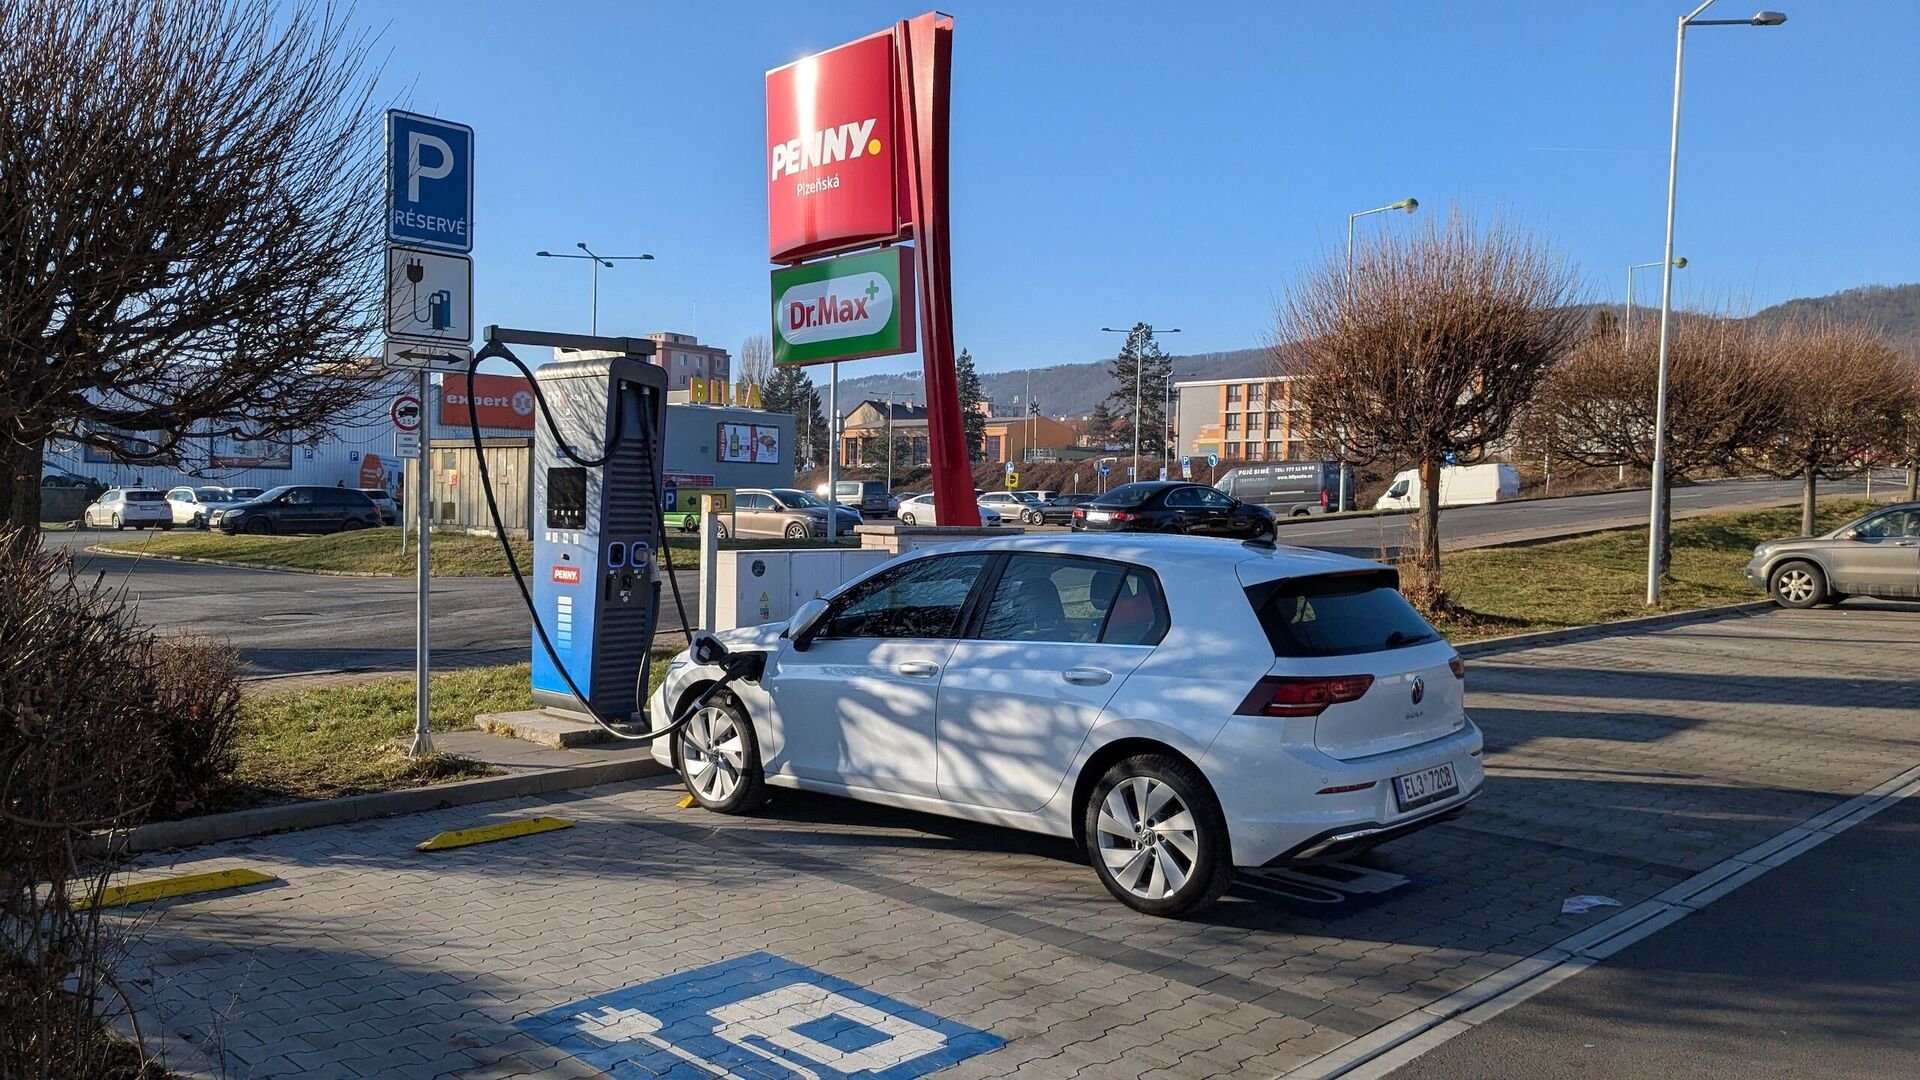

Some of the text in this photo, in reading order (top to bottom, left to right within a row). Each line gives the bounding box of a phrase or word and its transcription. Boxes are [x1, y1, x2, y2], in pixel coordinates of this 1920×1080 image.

[772, 118, 882, 182] PENNY.
[408, 131, 454, 203] P
[796, 174, 840, 197] Plzeňská
[395, 208, 466, 236] RÉSERVÉ
[790, 293, 869, 330] Dr.Max
[690, 377, 762, 407] BILLA
[352, 452, 358, 460] P
[665, 492, 675, 510] P
[1403, 766, 1452, 800] EL3 72CB
